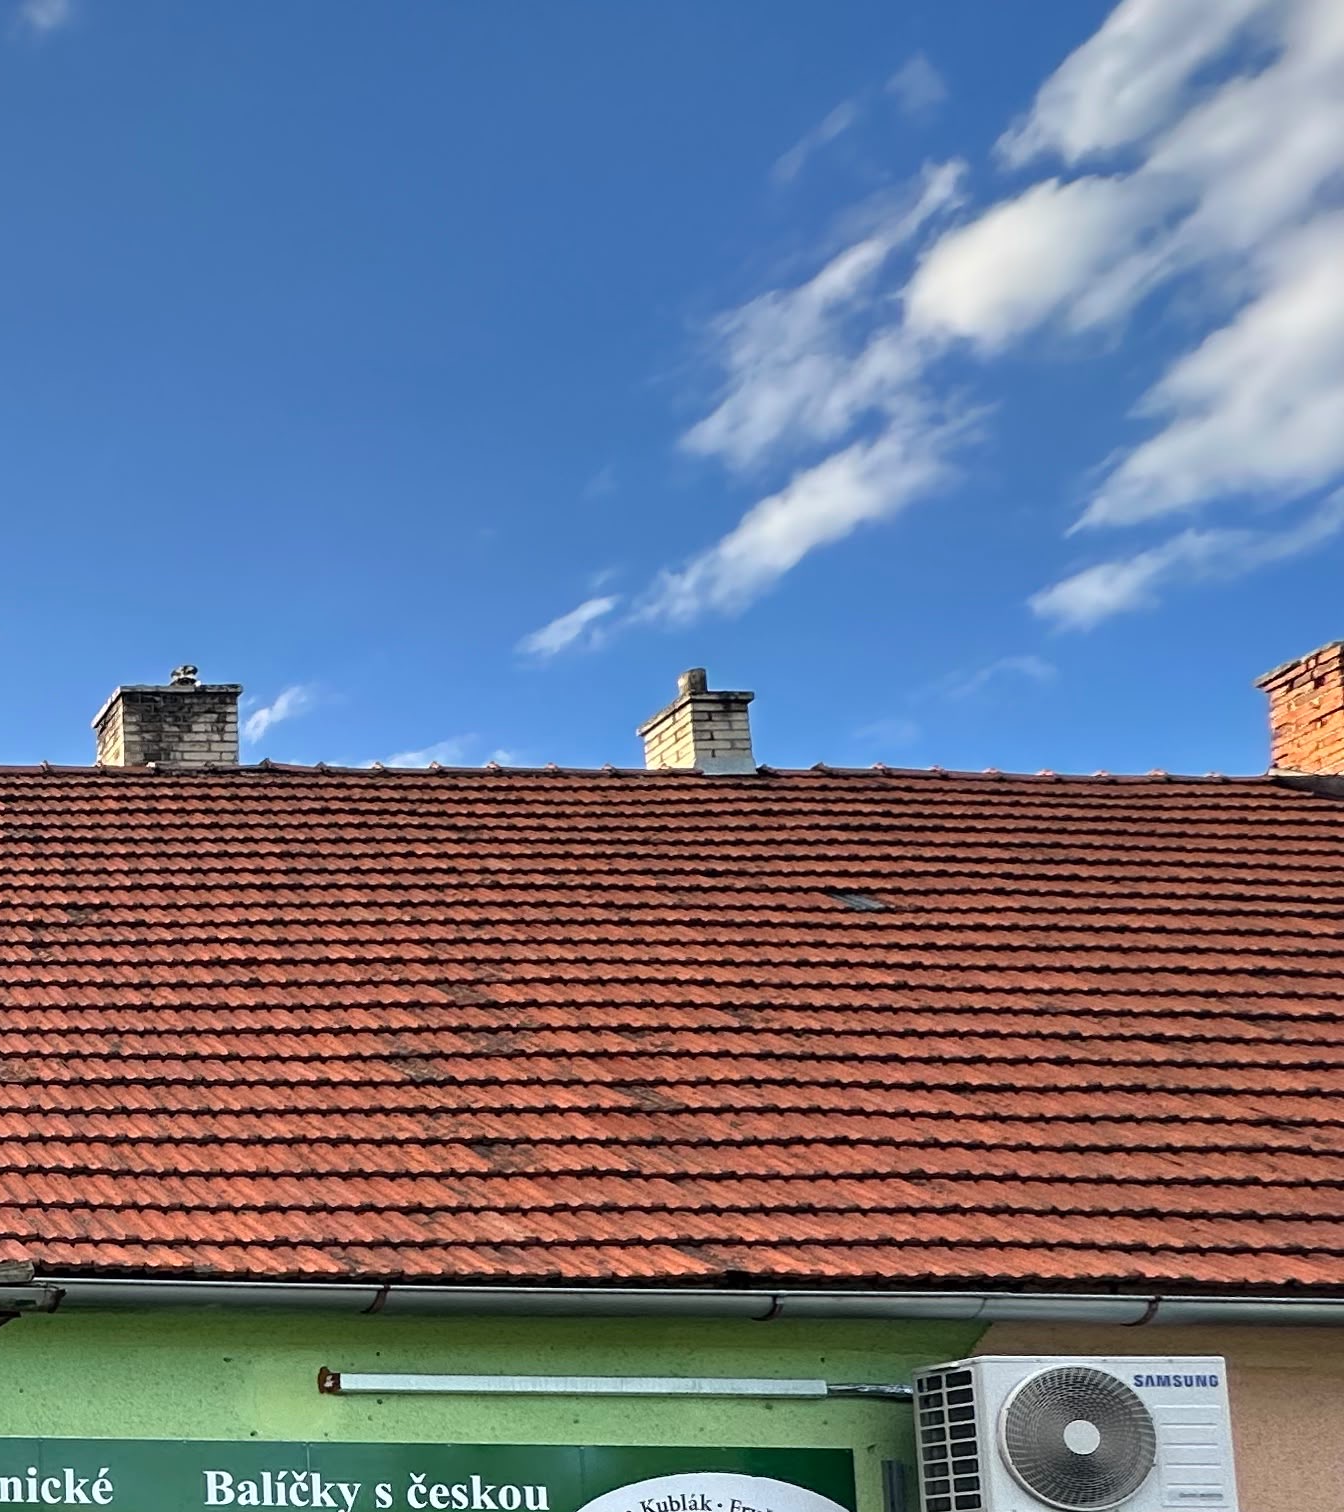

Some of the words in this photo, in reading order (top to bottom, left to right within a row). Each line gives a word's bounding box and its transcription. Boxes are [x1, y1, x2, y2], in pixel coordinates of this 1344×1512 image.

[1134, 1374, 1219, 1388] SAMSUNG
[374, 1480, 394, 1510] s
[406, 1471, 551, 1512] českou
